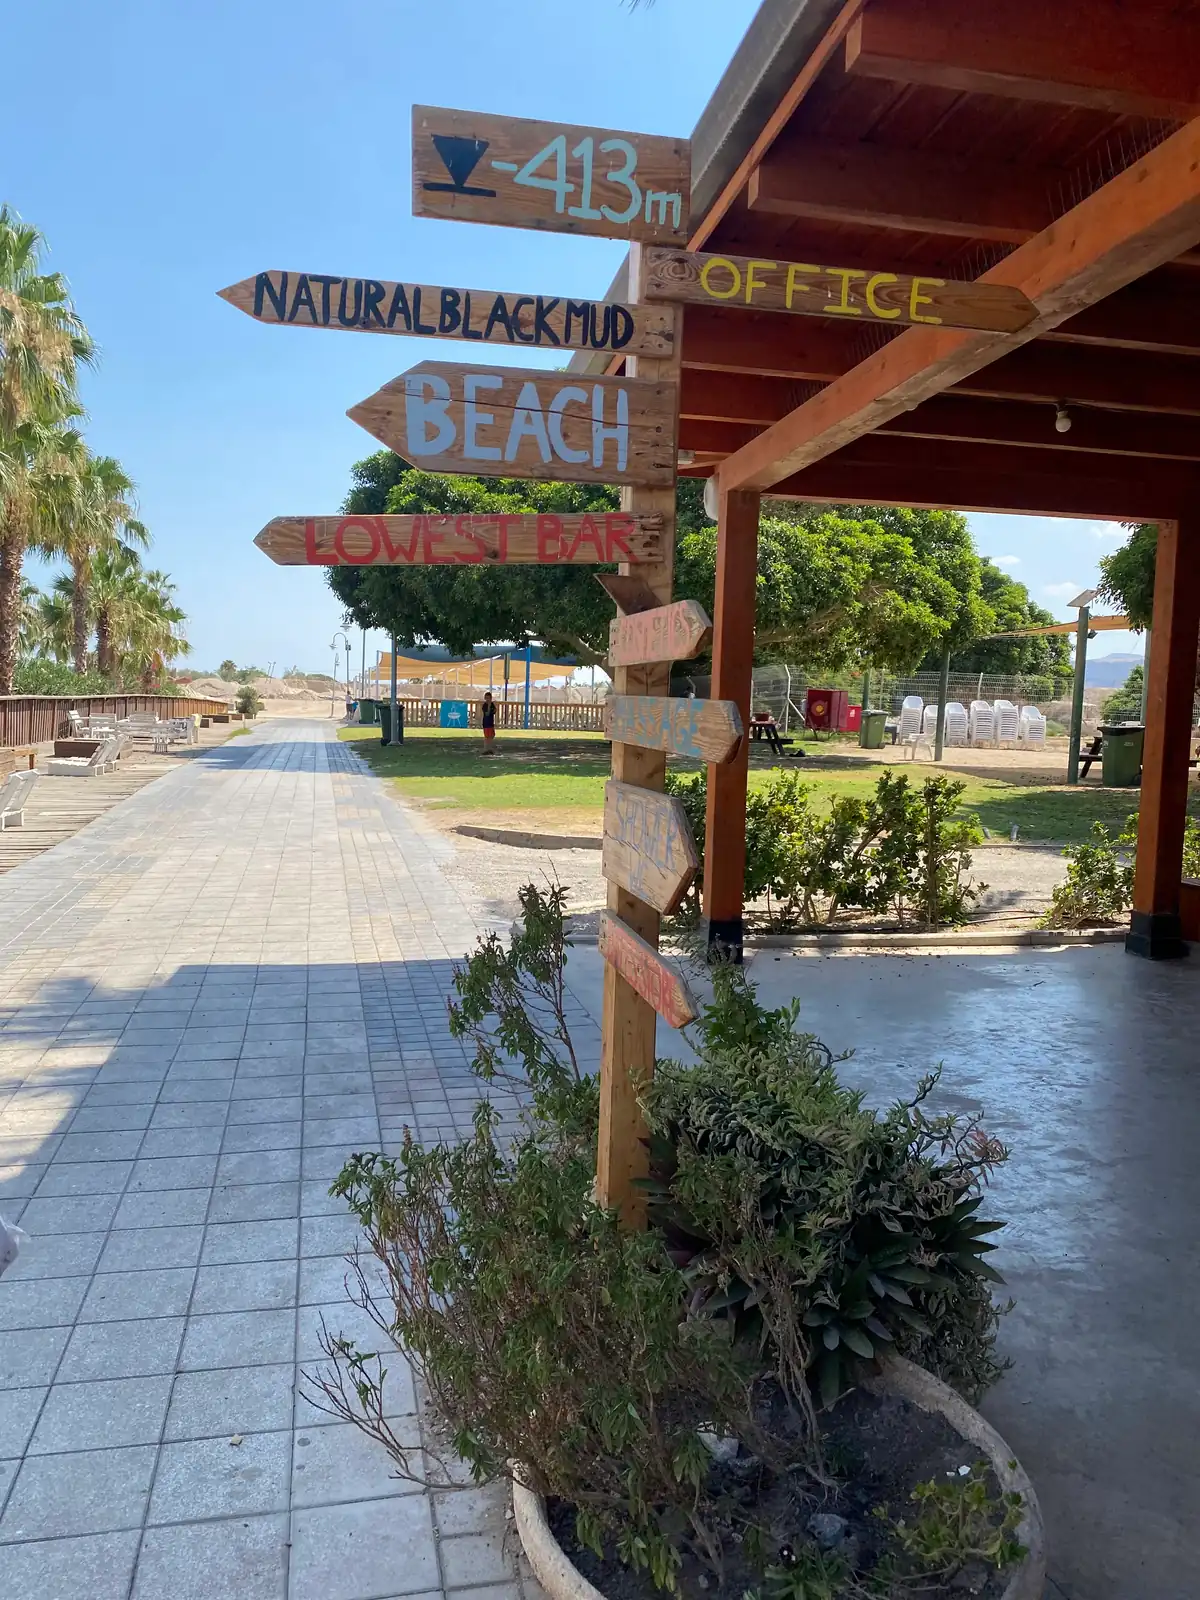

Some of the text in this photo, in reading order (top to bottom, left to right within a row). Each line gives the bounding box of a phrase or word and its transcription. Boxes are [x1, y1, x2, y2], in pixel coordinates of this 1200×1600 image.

[253, 272, 636, 350] NATURAL BLACK MUD
[700, 257, 946, 325] OFFICE
[404, 373, 630, 473] BEACH
[304, 511, 641, 564] LOWEST BAR
